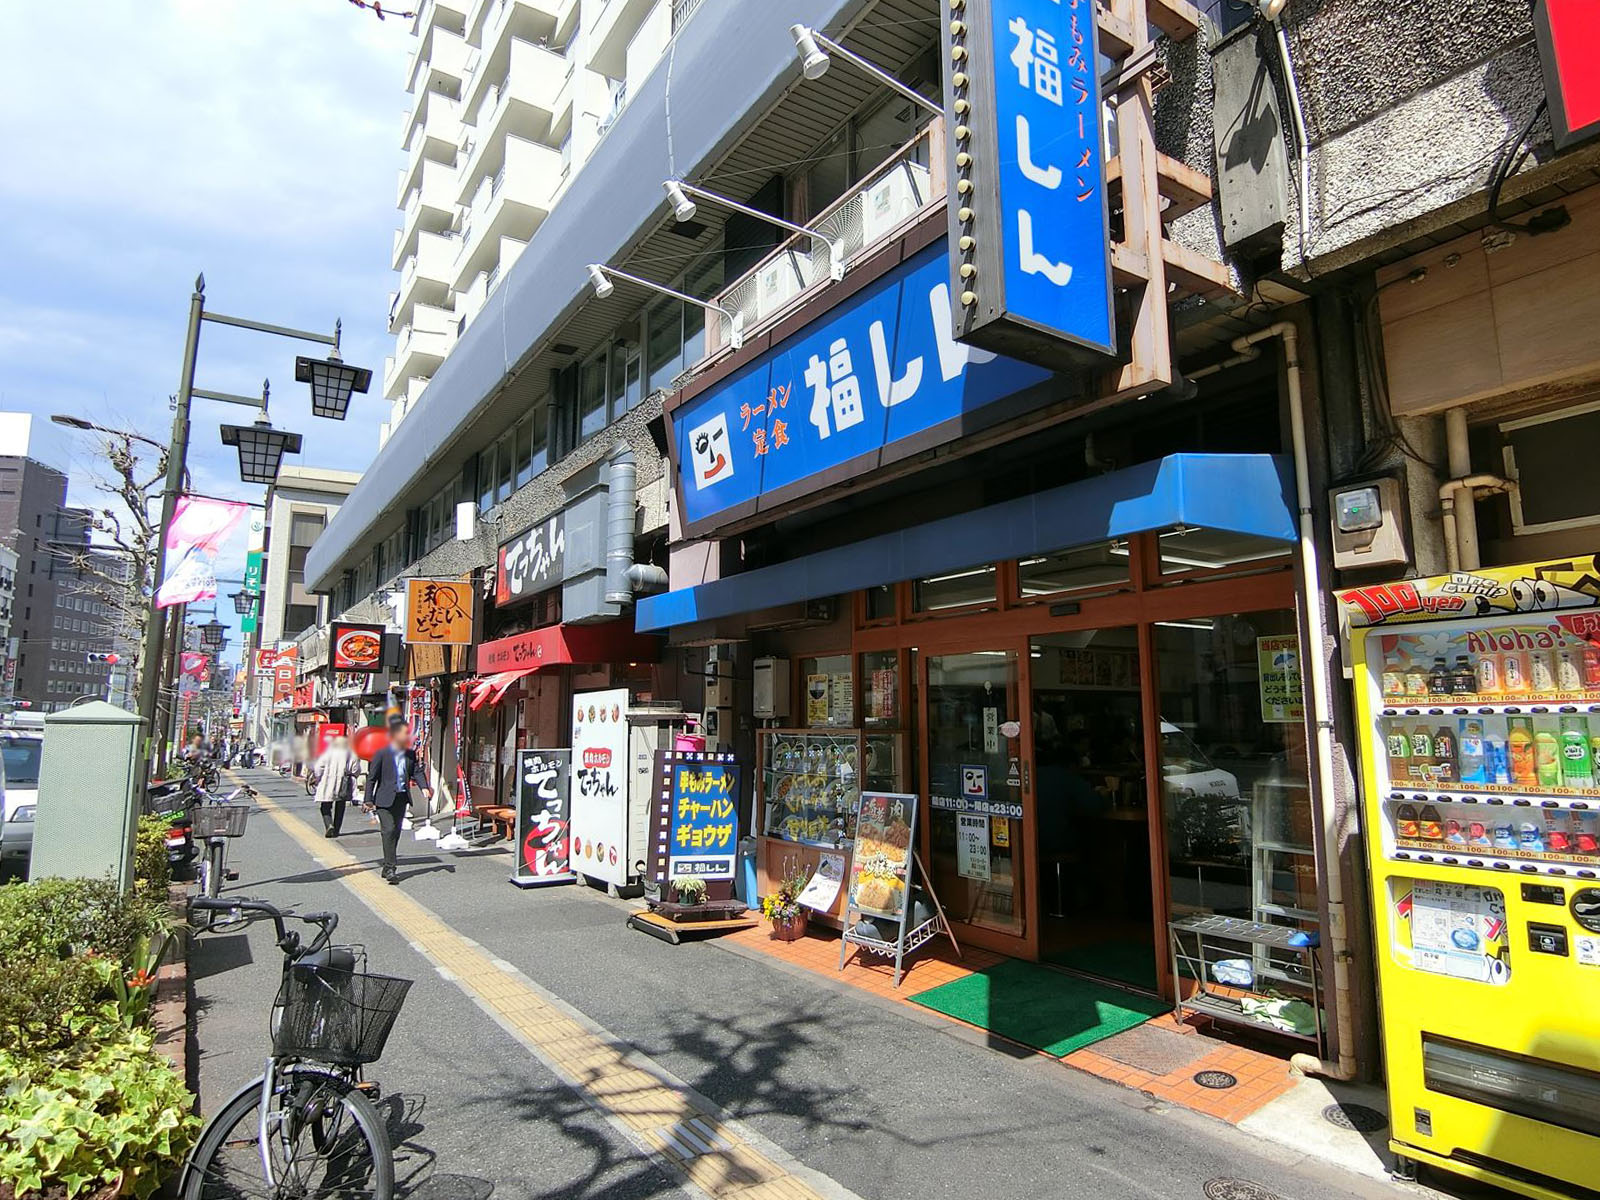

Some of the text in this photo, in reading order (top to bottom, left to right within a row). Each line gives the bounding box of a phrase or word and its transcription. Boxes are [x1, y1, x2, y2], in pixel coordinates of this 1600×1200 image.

[1068, 0, 1095, 203] もみラーメン
[1008, 17, 1073, 287] 福しん
[740, 380, 793, 432] ラーメン
[752, 418, 790, 459] 定食
[505, 517, 565, 595] てっちゃん
[1339, 582, 1465, 624] 100 yen
[1466, 624, 1567, 653] Aloha!
[530, 760, 563, 774] ホルモン
[679, 770, 736, 794] 手もみラーメン
[577, 767, 619, 798] てっちゃん
[525, 769, 568, 877] てっちゃん
[678, 797, 734, 821] チャーハン
[889, 799, 905, 819] 肉
[960, 816, 985, 829] 営業時間
[676, 823, 733, 848] ギョウザ
[694, 862, 727, 873] 福しん
